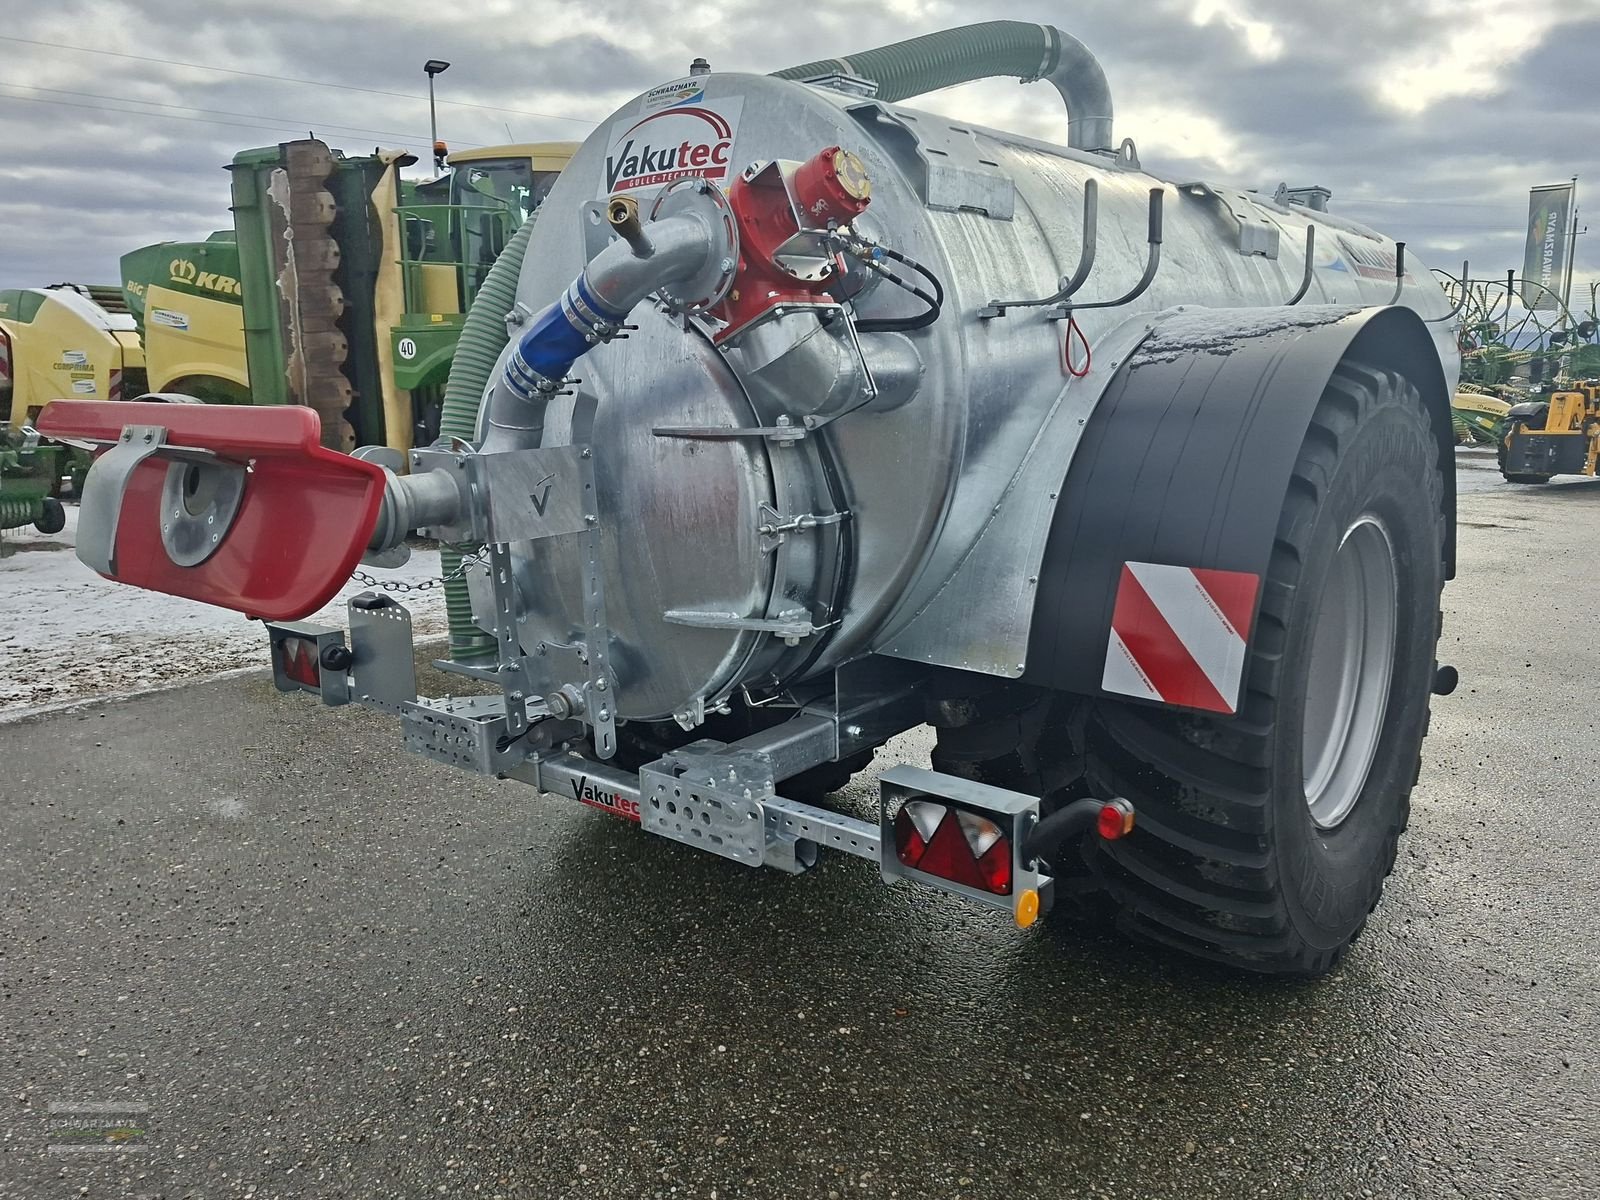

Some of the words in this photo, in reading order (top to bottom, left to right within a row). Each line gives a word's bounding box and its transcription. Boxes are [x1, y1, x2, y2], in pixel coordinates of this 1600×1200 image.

[647, 81, 698, 98] SCHWARZMAYR
[606, 140, 731, 194] Vakutec
[401, 341, 413, 356] 40
[53, 362, 94, 372] COMPRIMA
[571, 775, 640, 815] Vakutec
